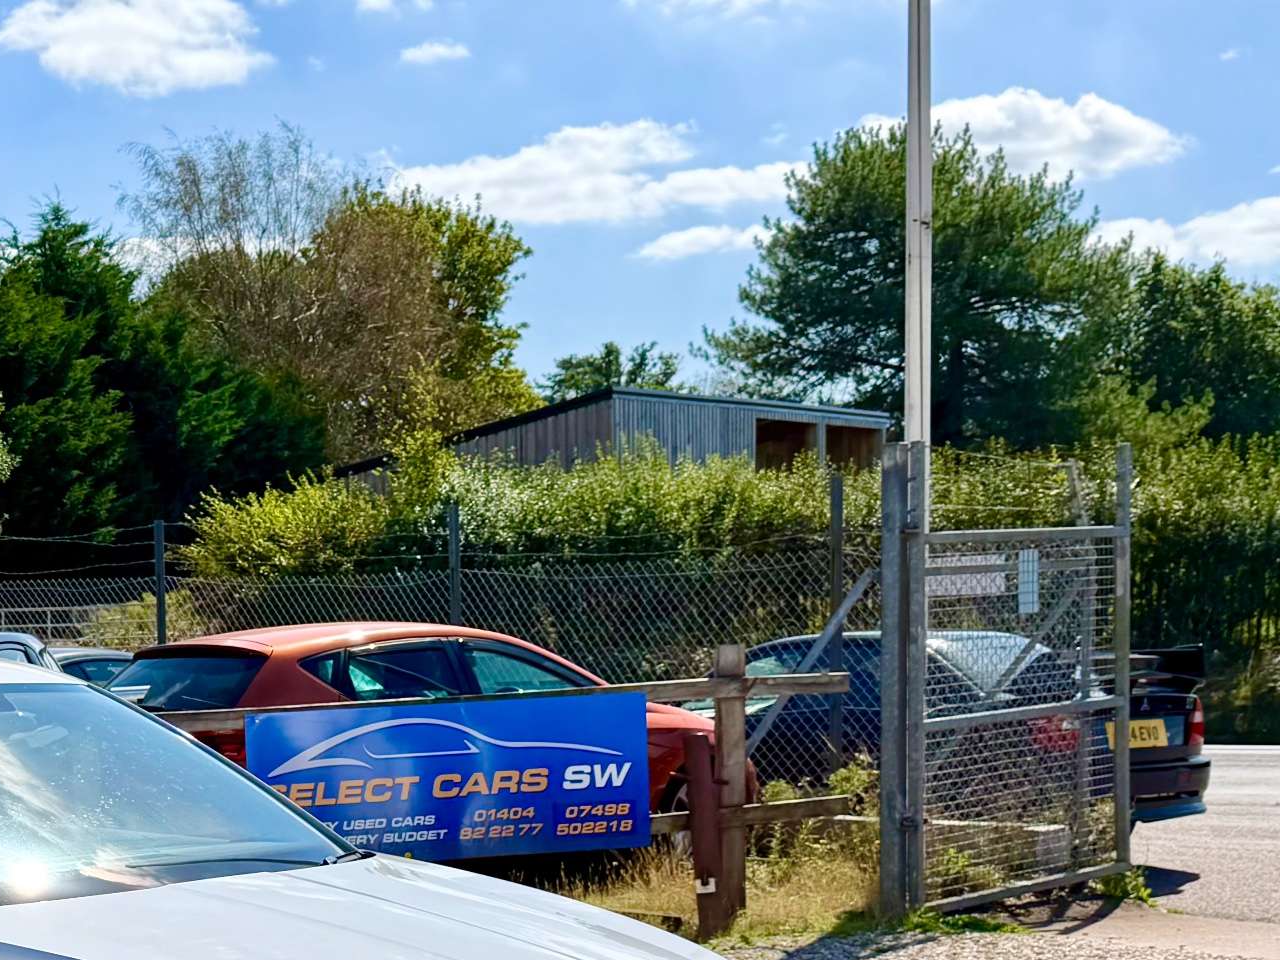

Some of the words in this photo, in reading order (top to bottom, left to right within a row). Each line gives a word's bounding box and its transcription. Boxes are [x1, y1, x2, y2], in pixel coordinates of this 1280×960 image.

[432, 767, 549, 799] CARS
[562, 762, 632, 790] SW
[474, 807, 536, 823] 01404
[565, 803, 631, 818] 07498
[342, 817, 387, 831] USED
[391, 815, 436, 828] CARS
[555, 819, 633, 836] 502218
[383, 829, 448, 844] BUDGET
